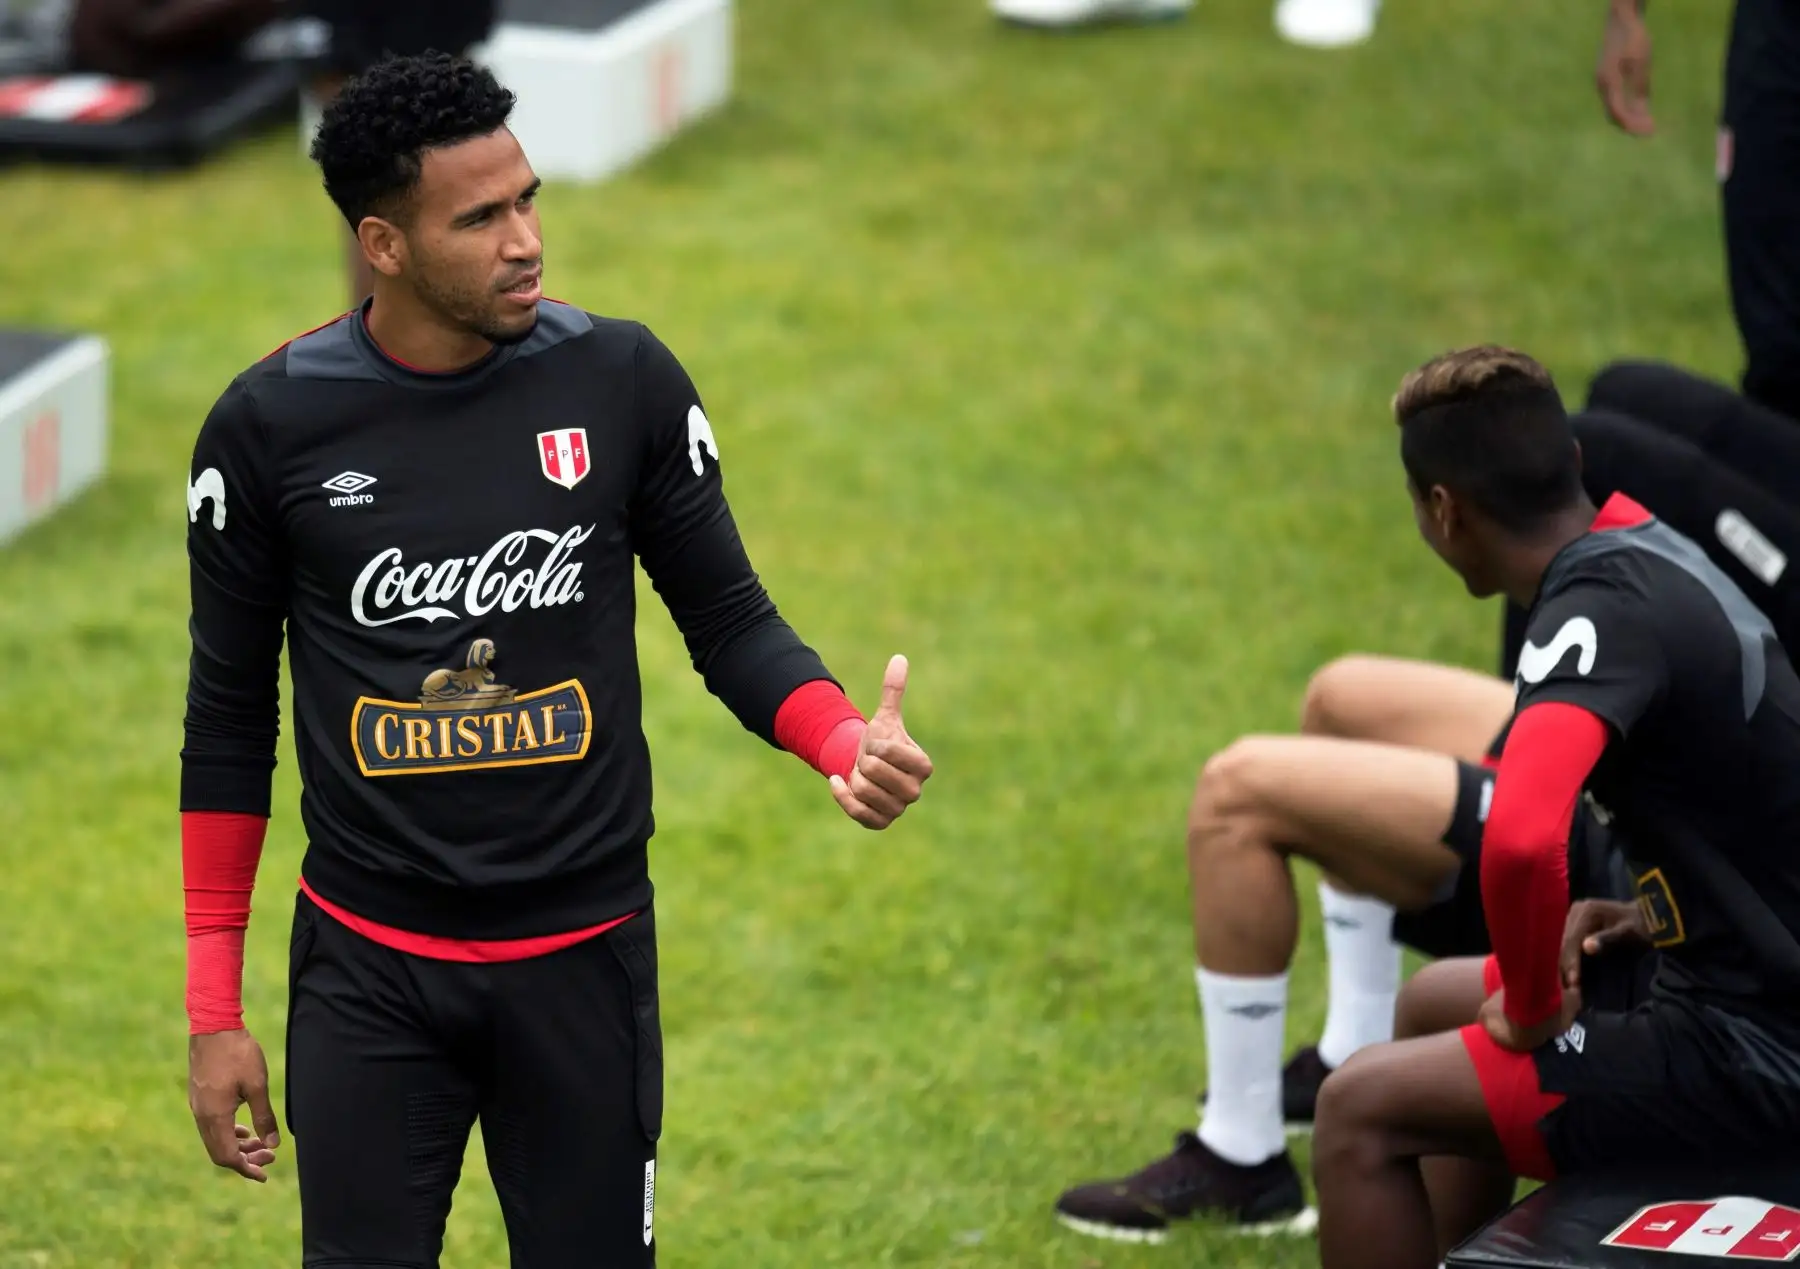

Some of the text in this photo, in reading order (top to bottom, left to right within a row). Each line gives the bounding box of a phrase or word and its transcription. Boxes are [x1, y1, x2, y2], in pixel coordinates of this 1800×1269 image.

[329, 494, 374, 507] umbro
[351, 523, 596, 627] Coca-Cola
[374, 704, 566, 760] CRISTAL
